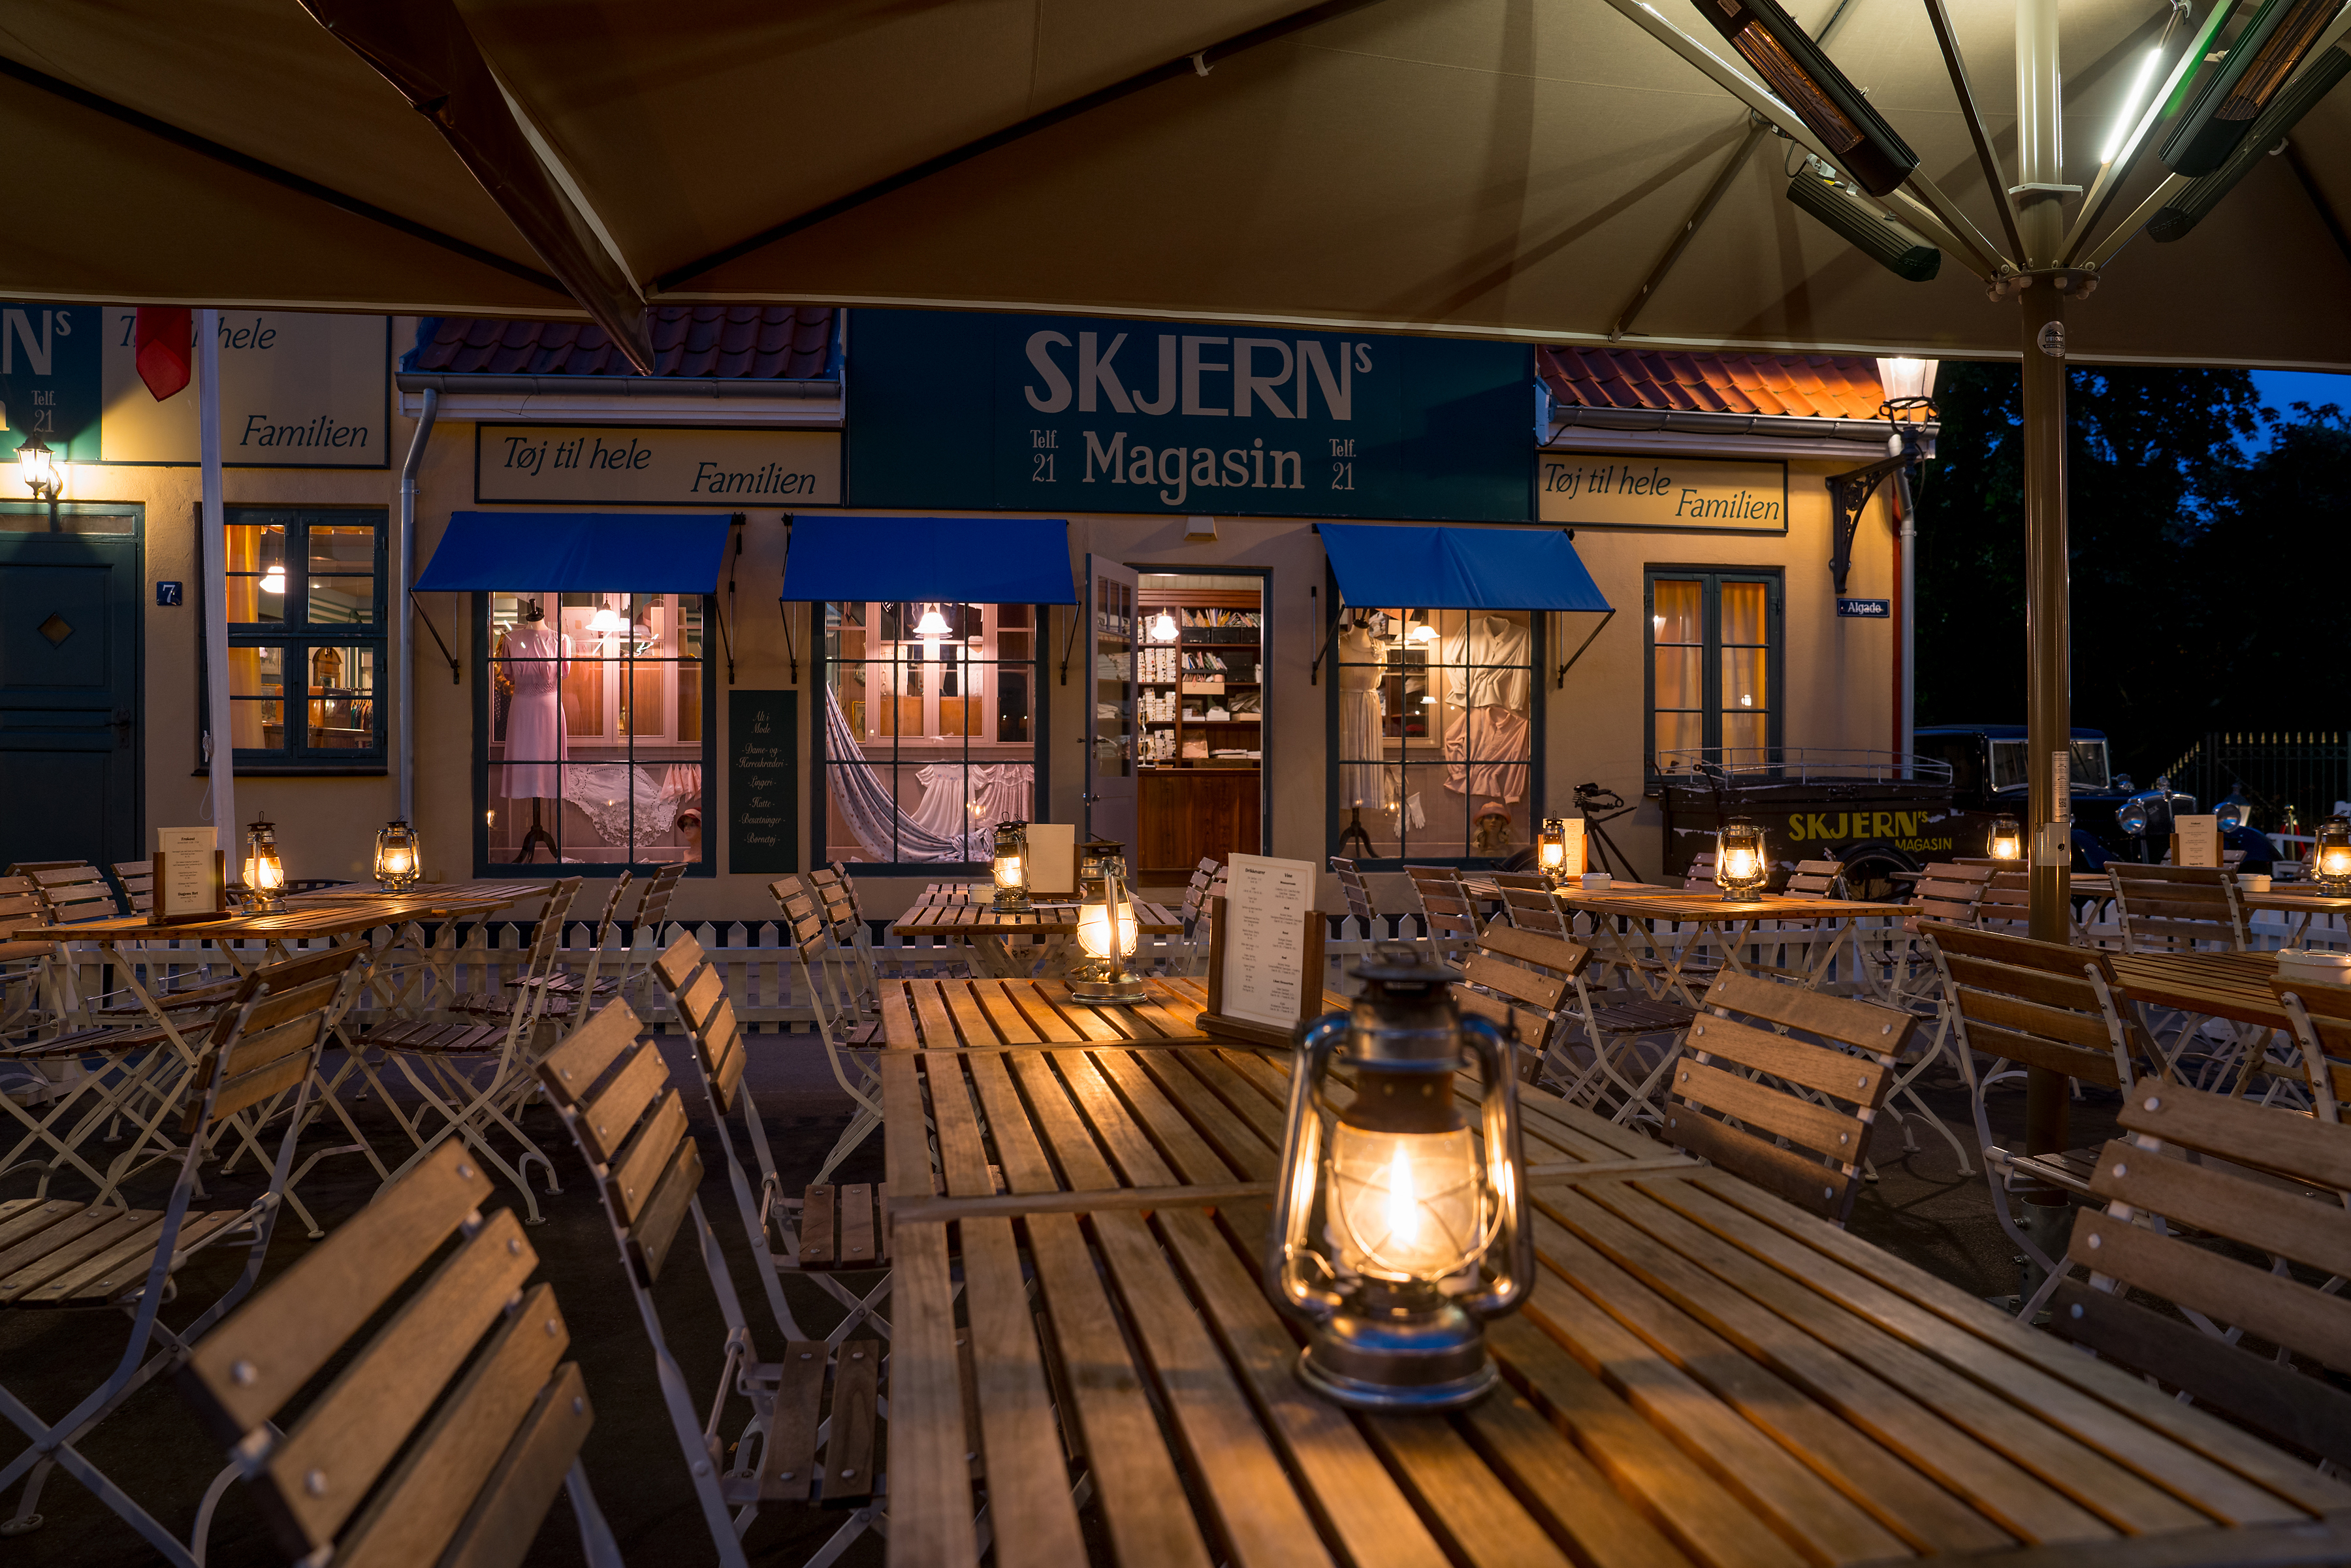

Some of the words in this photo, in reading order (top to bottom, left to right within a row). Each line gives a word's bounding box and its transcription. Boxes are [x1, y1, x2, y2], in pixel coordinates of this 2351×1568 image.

[31, 391, 56, 406] Telf.
[33, 409, 54, 432] 21
[240, 415, 368, 448] Familien
[1030, 430, 1059, 449] Telf.
[504, 437, 548, 476] Tøj
[554, 437, 585, 469] til
[589, 438, 652, 470] hele
[1329, 439, 1356, 457] Telf.
[690, 462, 816, 495] Familien
[1032, 454, 1057, 482] 21
[1082, 431, 1305, 505] Magasin
[1332, 462, 1355, 490] 21
[1545, 464, 1582, 500] Tøj
[1588, 466, 1614, 494] til
[1618, 466, 1671, 496] hele
[1675, 488, 1780, 520] Familien
[162, 585, 176, 604] 7
[1847, 601, 1881, 615] Algade
[766, 712, 770, 721] i
[751, 722, 771, 733] Mode
[769, 748, 778, 758] og
[1895, 837, 1952, 852] MAGASIN
